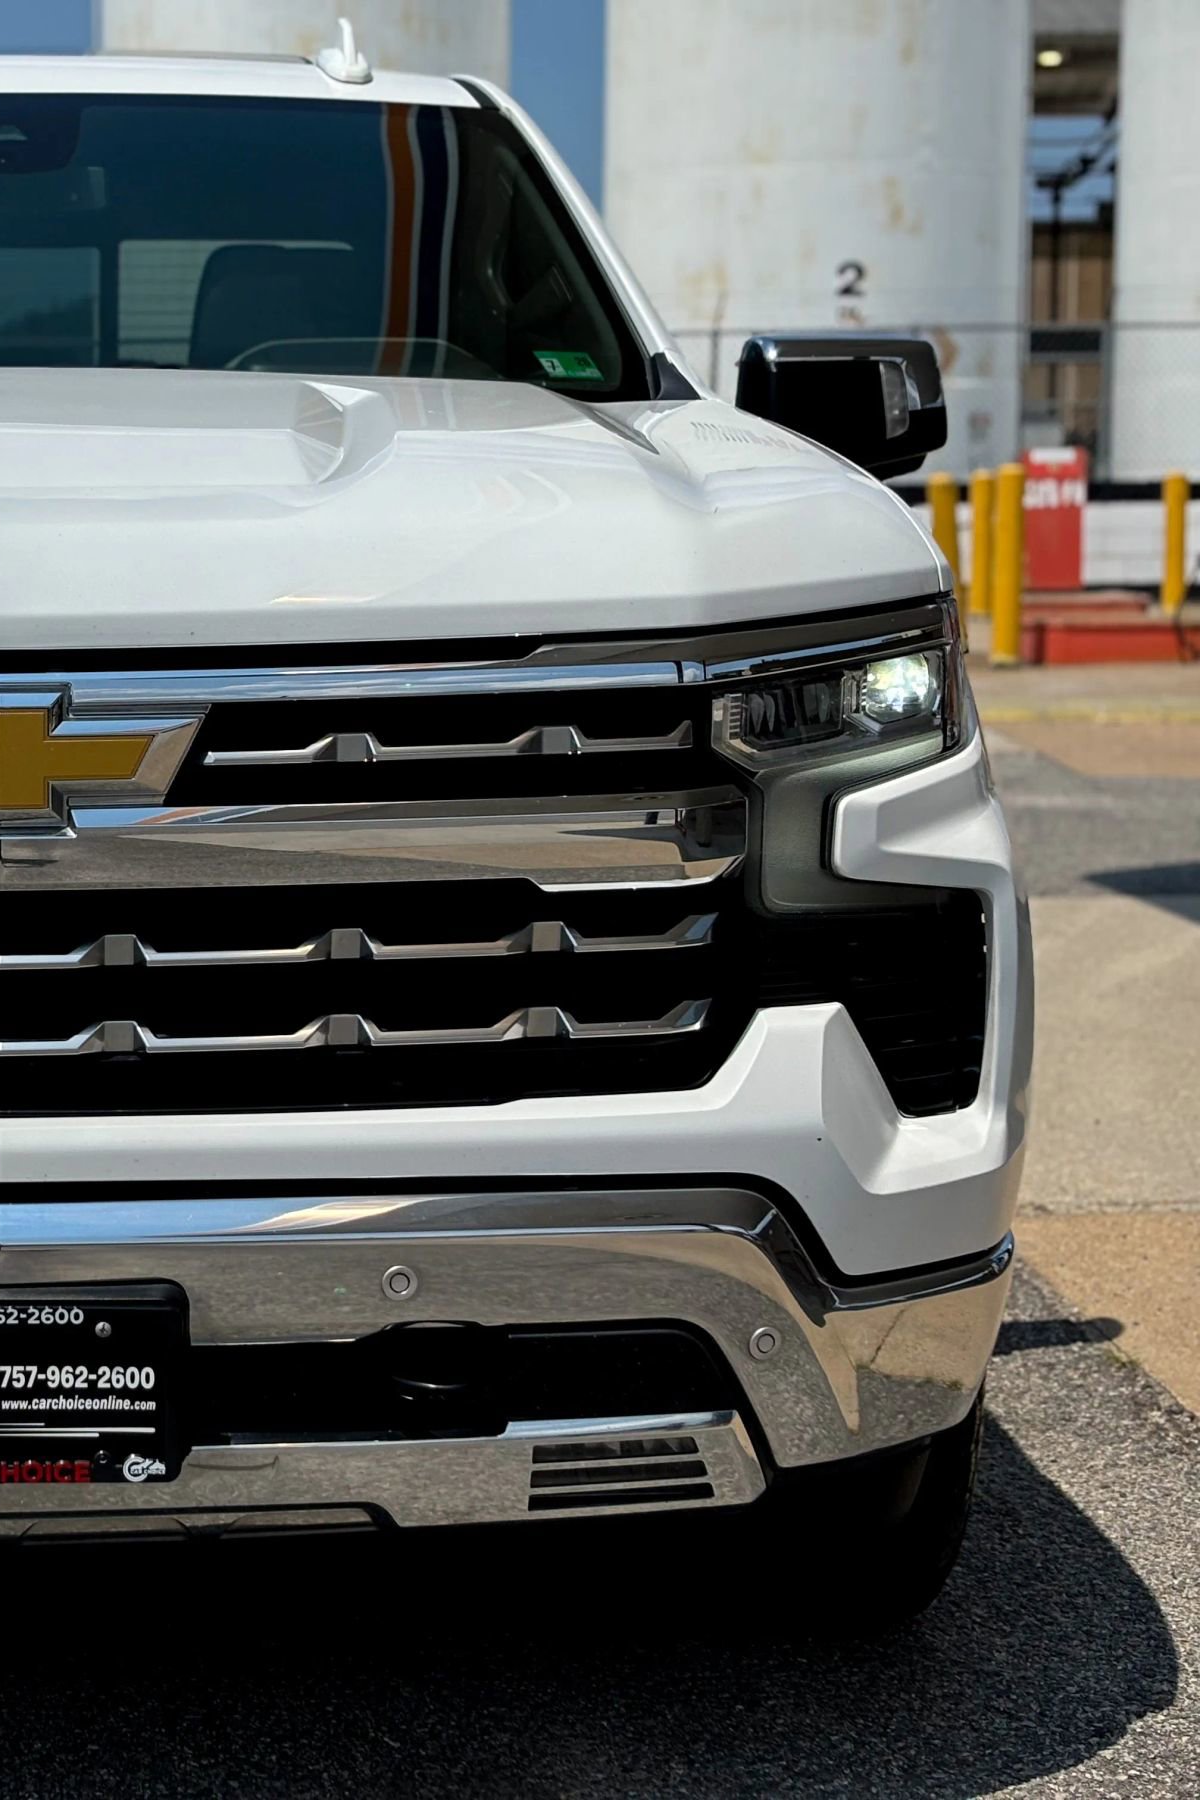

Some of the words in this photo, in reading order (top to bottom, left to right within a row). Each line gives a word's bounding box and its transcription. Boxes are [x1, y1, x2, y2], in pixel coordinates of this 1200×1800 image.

[837, 260, 865, 297] 2
[0, 1365, 155, 1389] 757-962-2600
[1, 1395, 156, 1411] www.carchoiceonline.com
